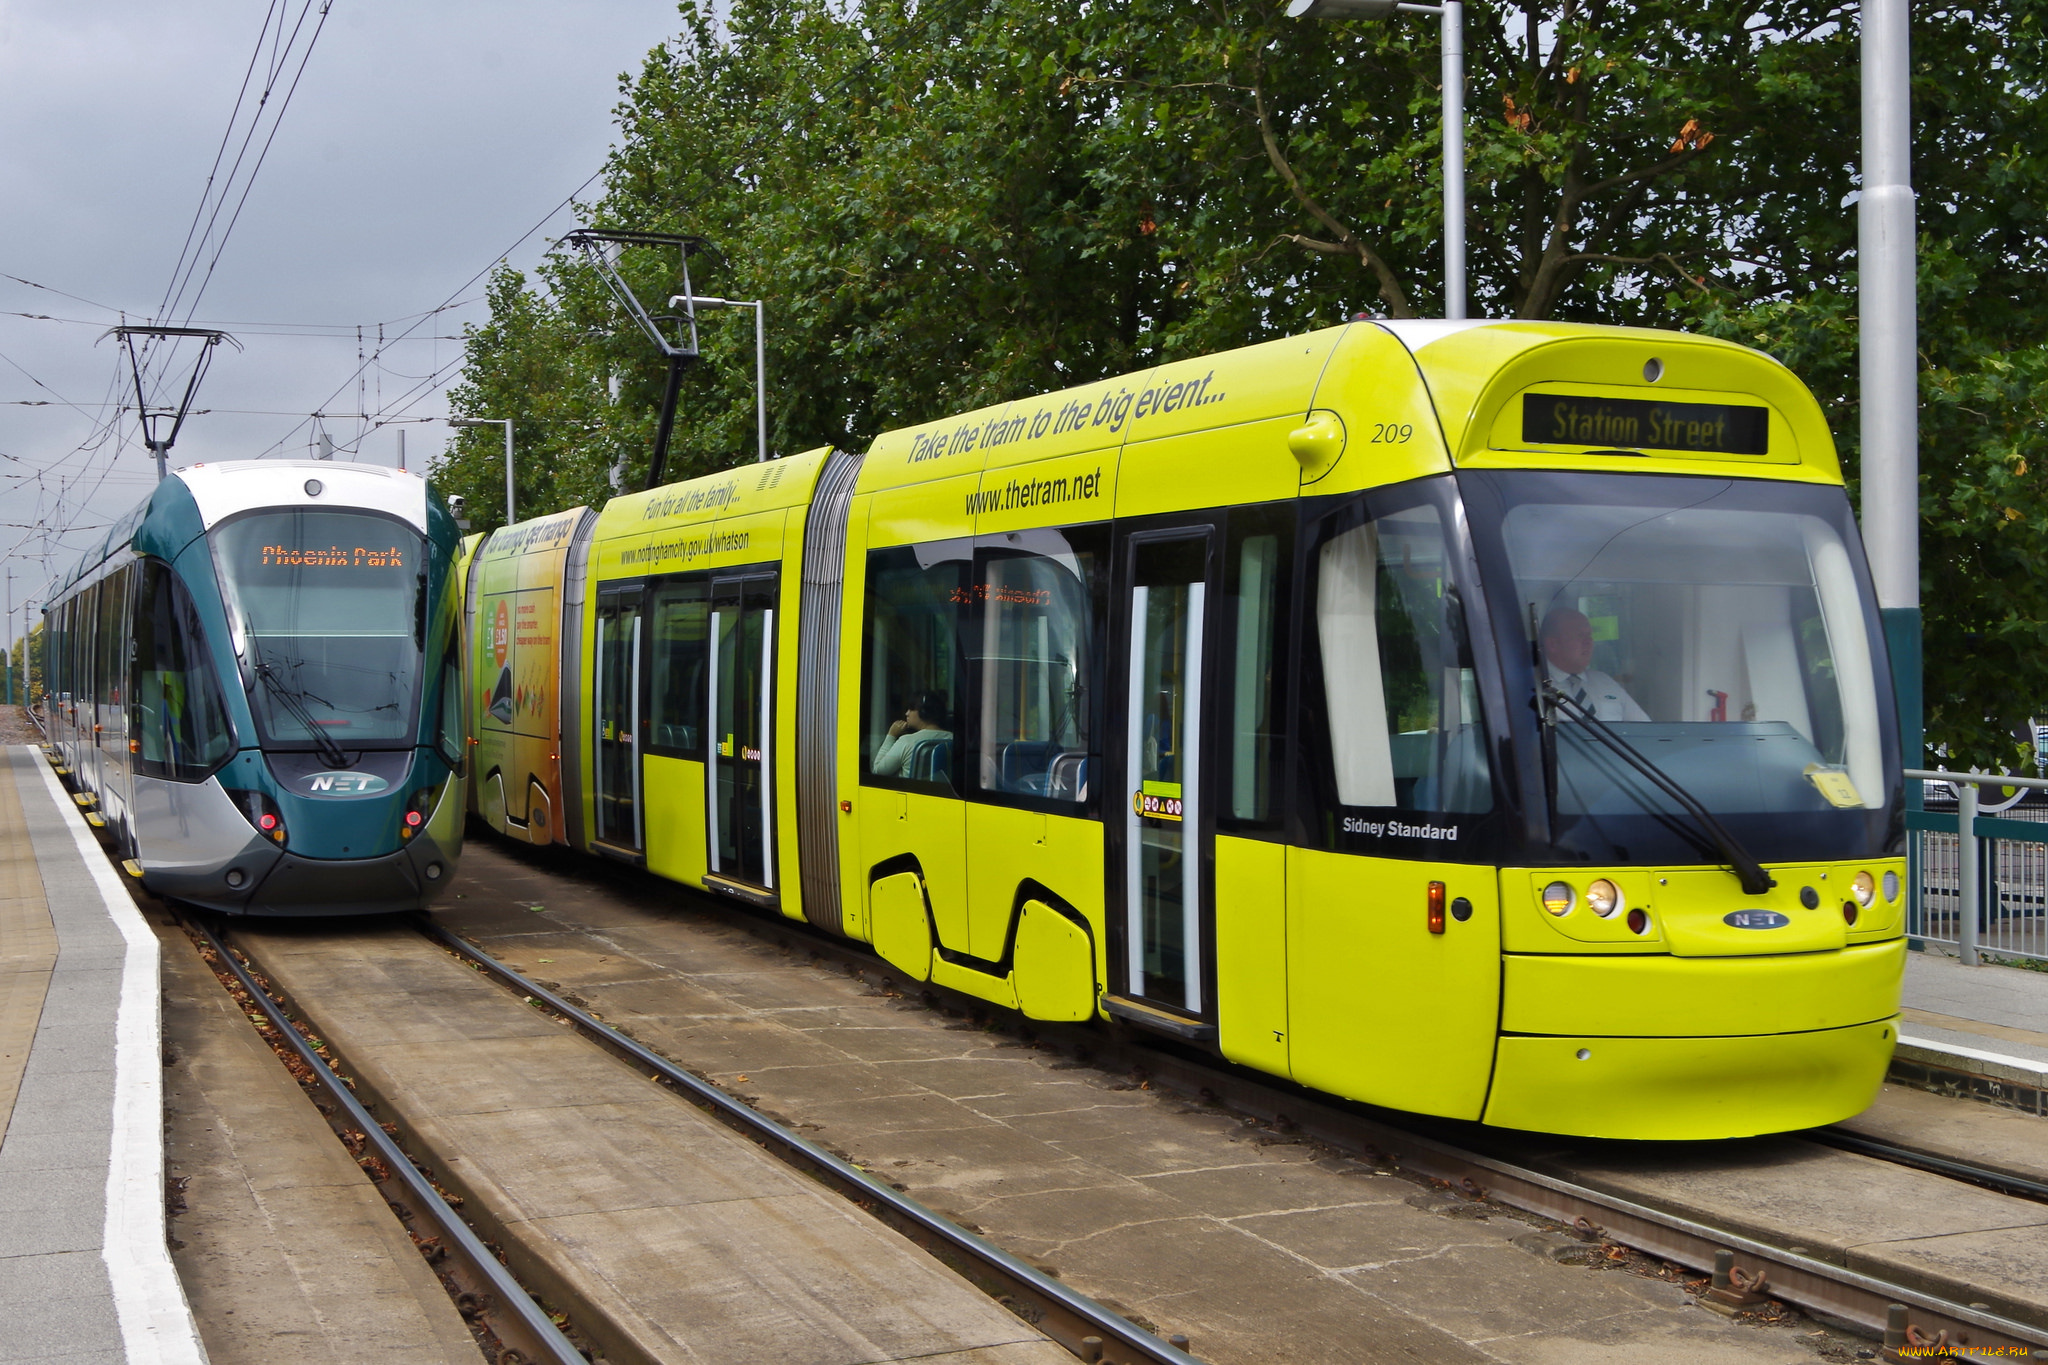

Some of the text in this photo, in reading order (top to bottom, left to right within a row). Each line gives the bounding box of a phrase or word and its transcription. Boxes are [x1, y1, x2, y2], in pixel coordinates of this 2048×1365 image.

[907, 370, 1226, 464] Take the tram to the big event...
[1552, 401, 1726, 447] Station Street
[1370, 423, 1413, 444] 209
[642, 498, 662, 520] Fun
[660, 494, 676, 517] for
[674, 490, 691, 515] all
[687, 488, 705, 512] the
[965, 466, 1101, 516] www.thetram.net
[262, 545, 402, 566] Phoenix Park
[621, 531, 749, 566] www.nottinghamcity.gov.uk/whatson
[310, 776, 375, 791] NET
[1342, 817, 1458, 841] Sidney Standard
[1735, 913, 1778, 926] NET
